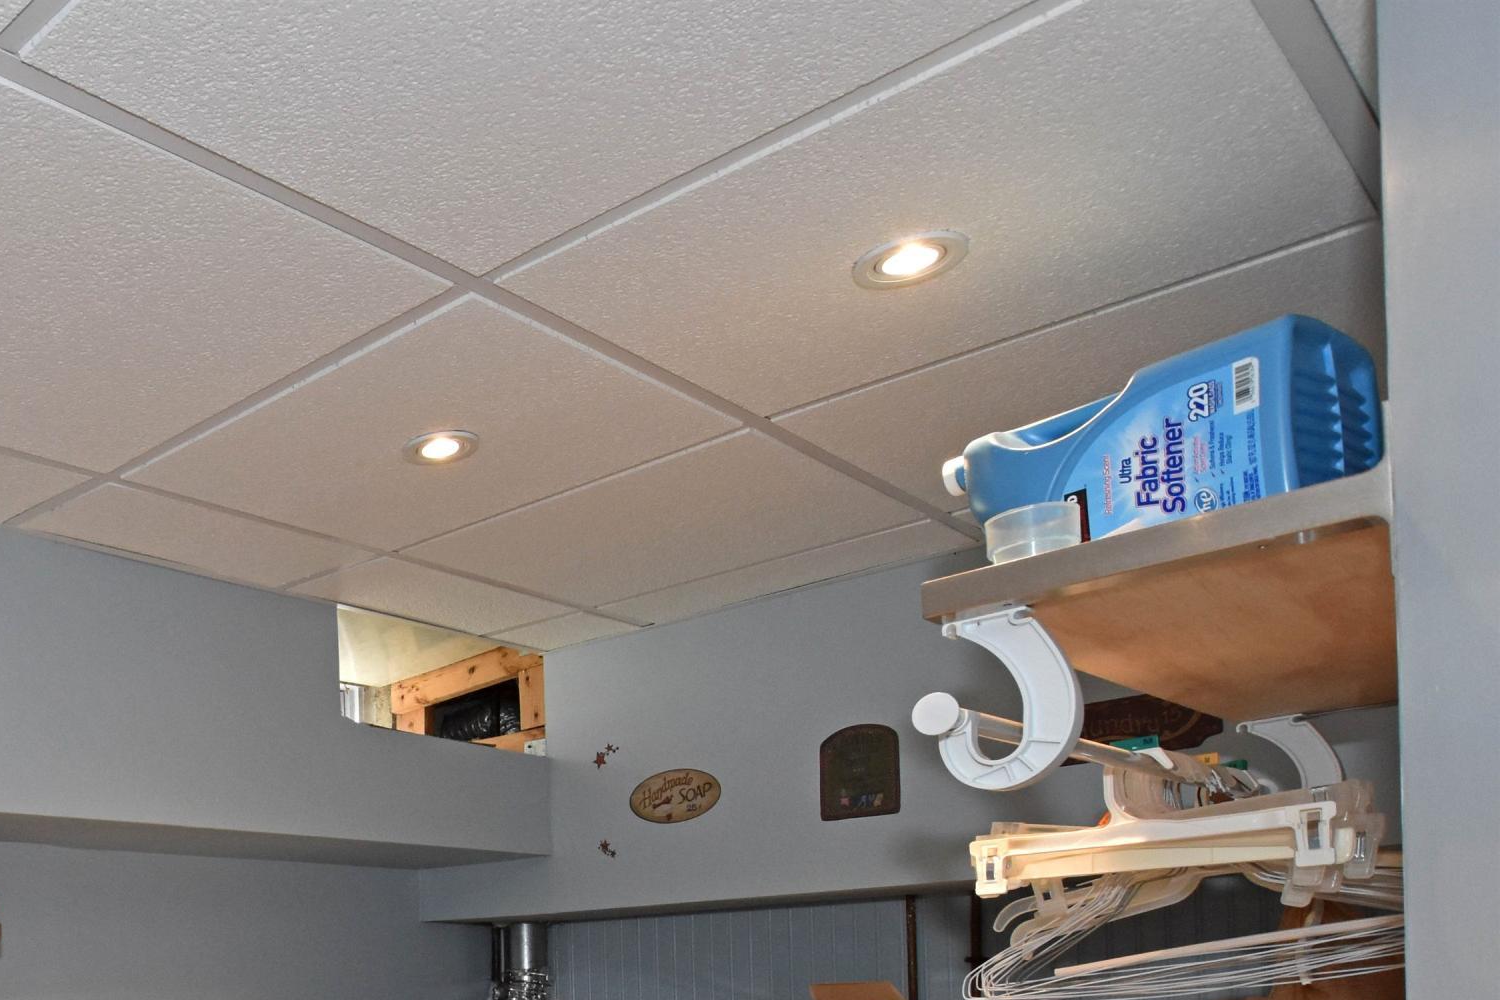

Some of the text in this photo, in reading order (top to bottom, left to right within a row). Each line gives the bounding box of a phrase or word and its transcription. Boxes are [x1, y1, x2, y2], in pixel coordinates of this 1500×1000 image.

[1187, 381, 1209, 422] 220
[1119, 457, 1132, 484] Ultra
[1135, 436, 1160, 507] Fabric
[1160, 417, 1186, 513] Softener
[639, 772, 694, 810] Handmade
[678, 782, 713, 805] SOAP
